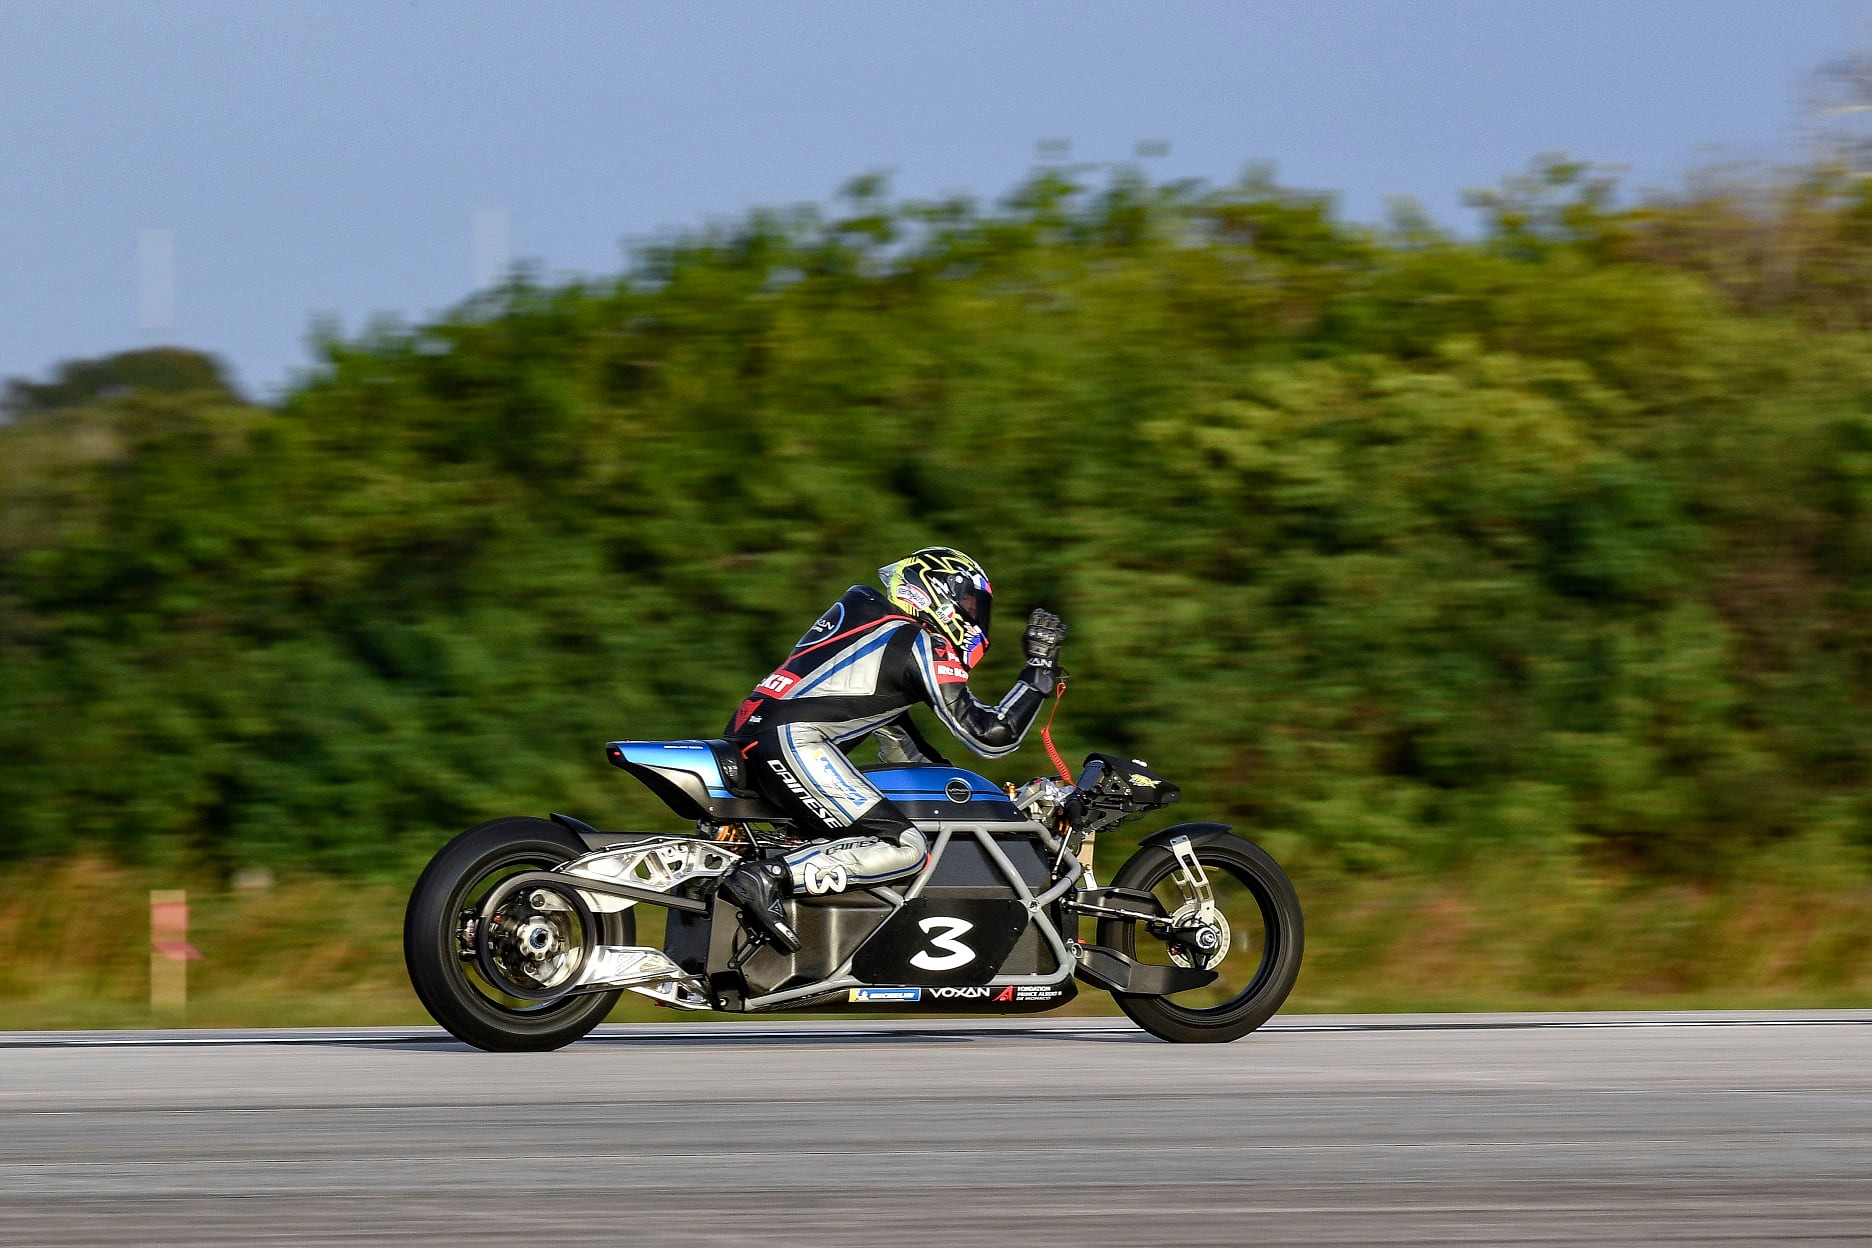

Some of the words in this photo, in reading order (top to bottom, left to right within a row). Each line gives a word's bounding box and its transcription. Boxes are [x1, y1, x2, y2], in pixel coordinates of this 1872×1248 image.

[767, 759, 843, 829] DAINESE
[909, 916, 977, 971] 3
[928, 987, 990, 998] VOXAN
